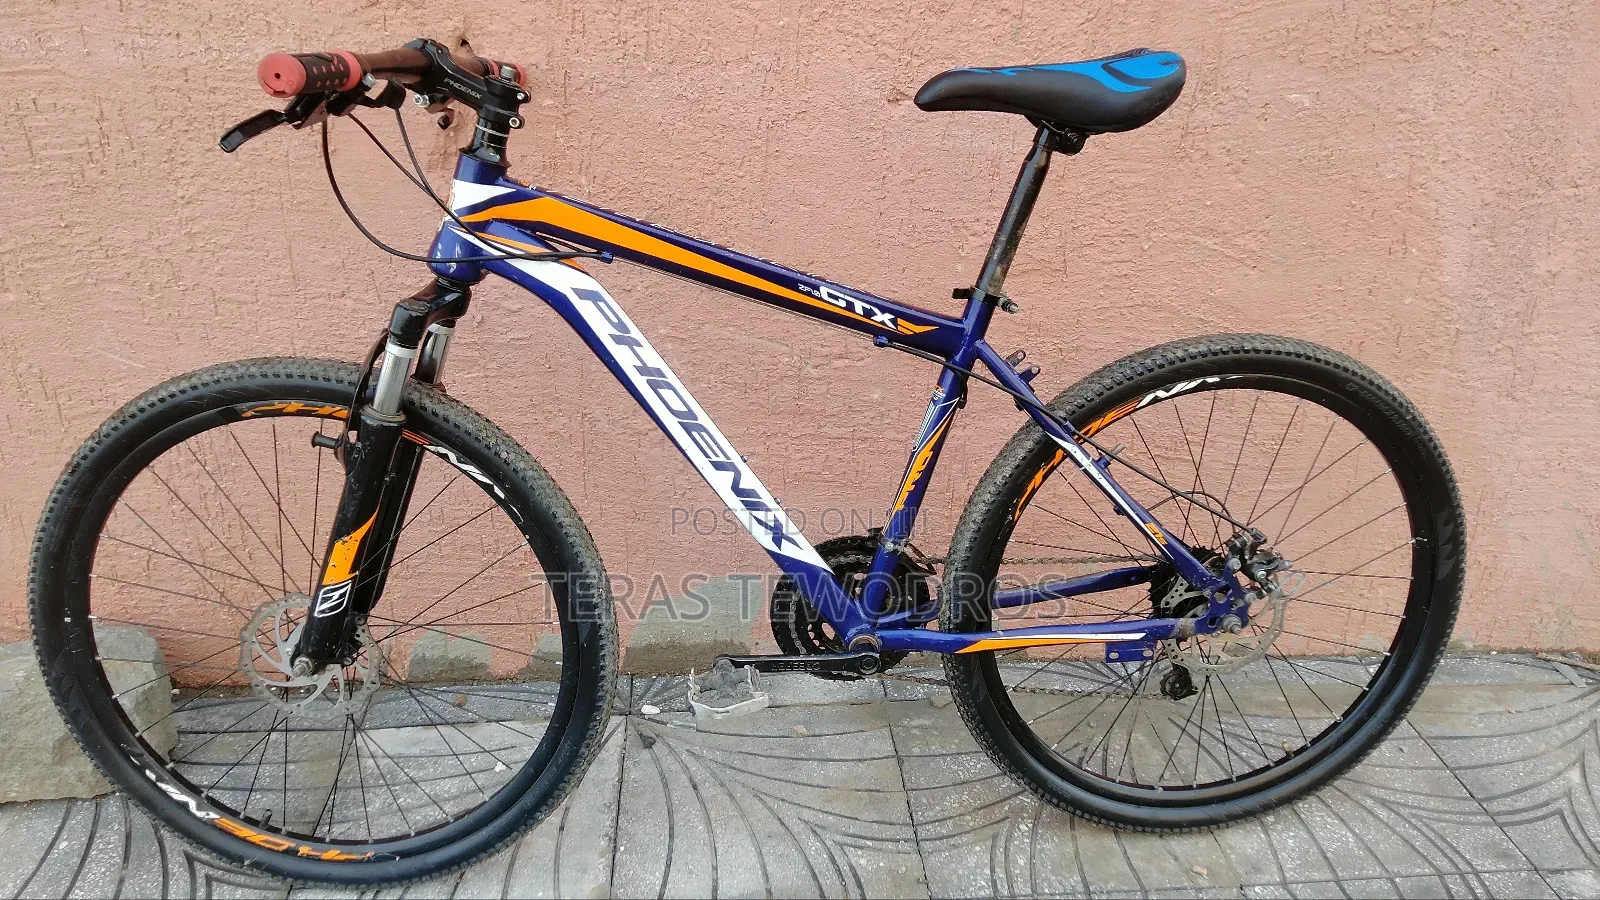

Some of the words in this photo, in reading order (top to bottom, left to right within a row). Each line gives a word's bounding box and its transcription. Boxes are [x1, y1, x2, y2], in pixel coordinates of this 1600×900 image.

[444, 77, 483, 100] PHOENIX
[819, 286, 898, 330] GTX
[570, 287, 804, 552] PHOENIX
